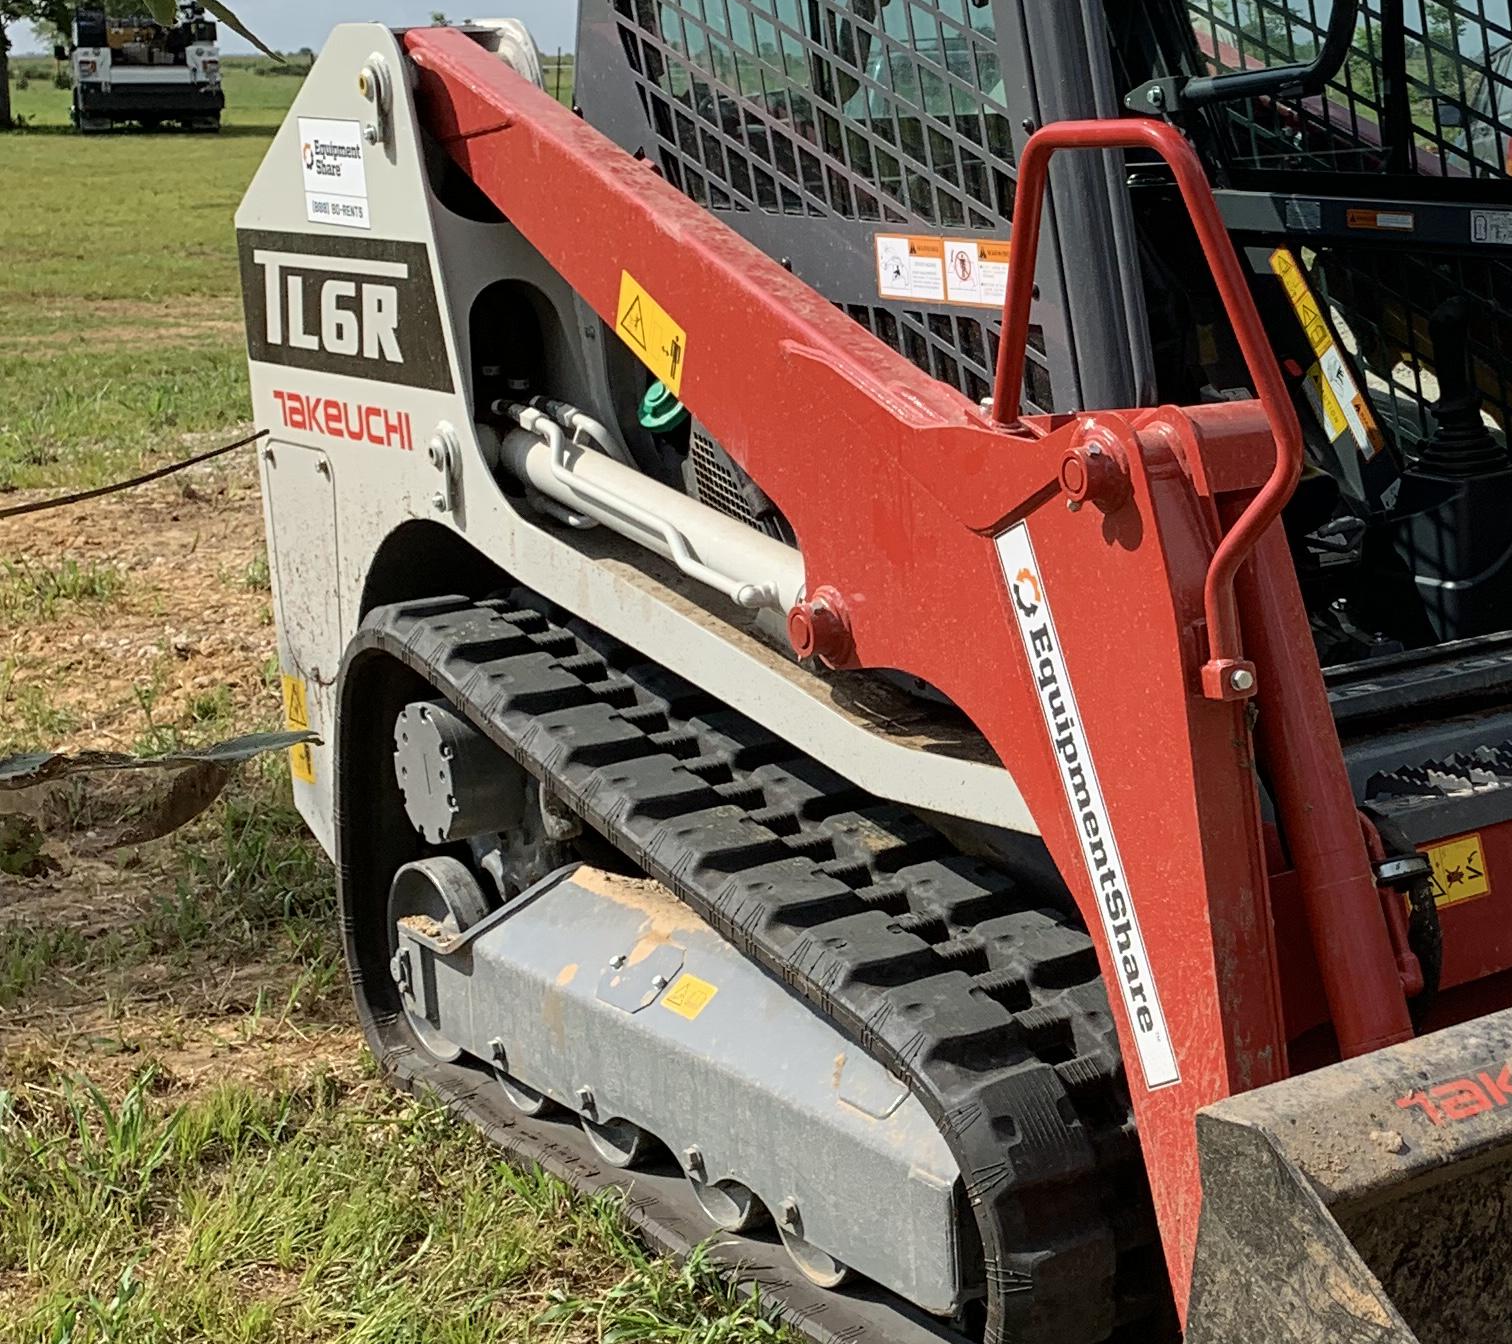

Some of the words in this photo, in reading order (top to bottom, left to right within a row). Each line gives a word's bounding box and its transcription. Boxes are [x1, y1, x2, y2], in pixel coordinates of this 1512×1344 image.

[314, 139, 361, 160] Equipment
[316, 159, 342, 176] Share
[254, 249, 408, 364] TL6R
[1029, 622, 1154, 1034] EquipmentShare
